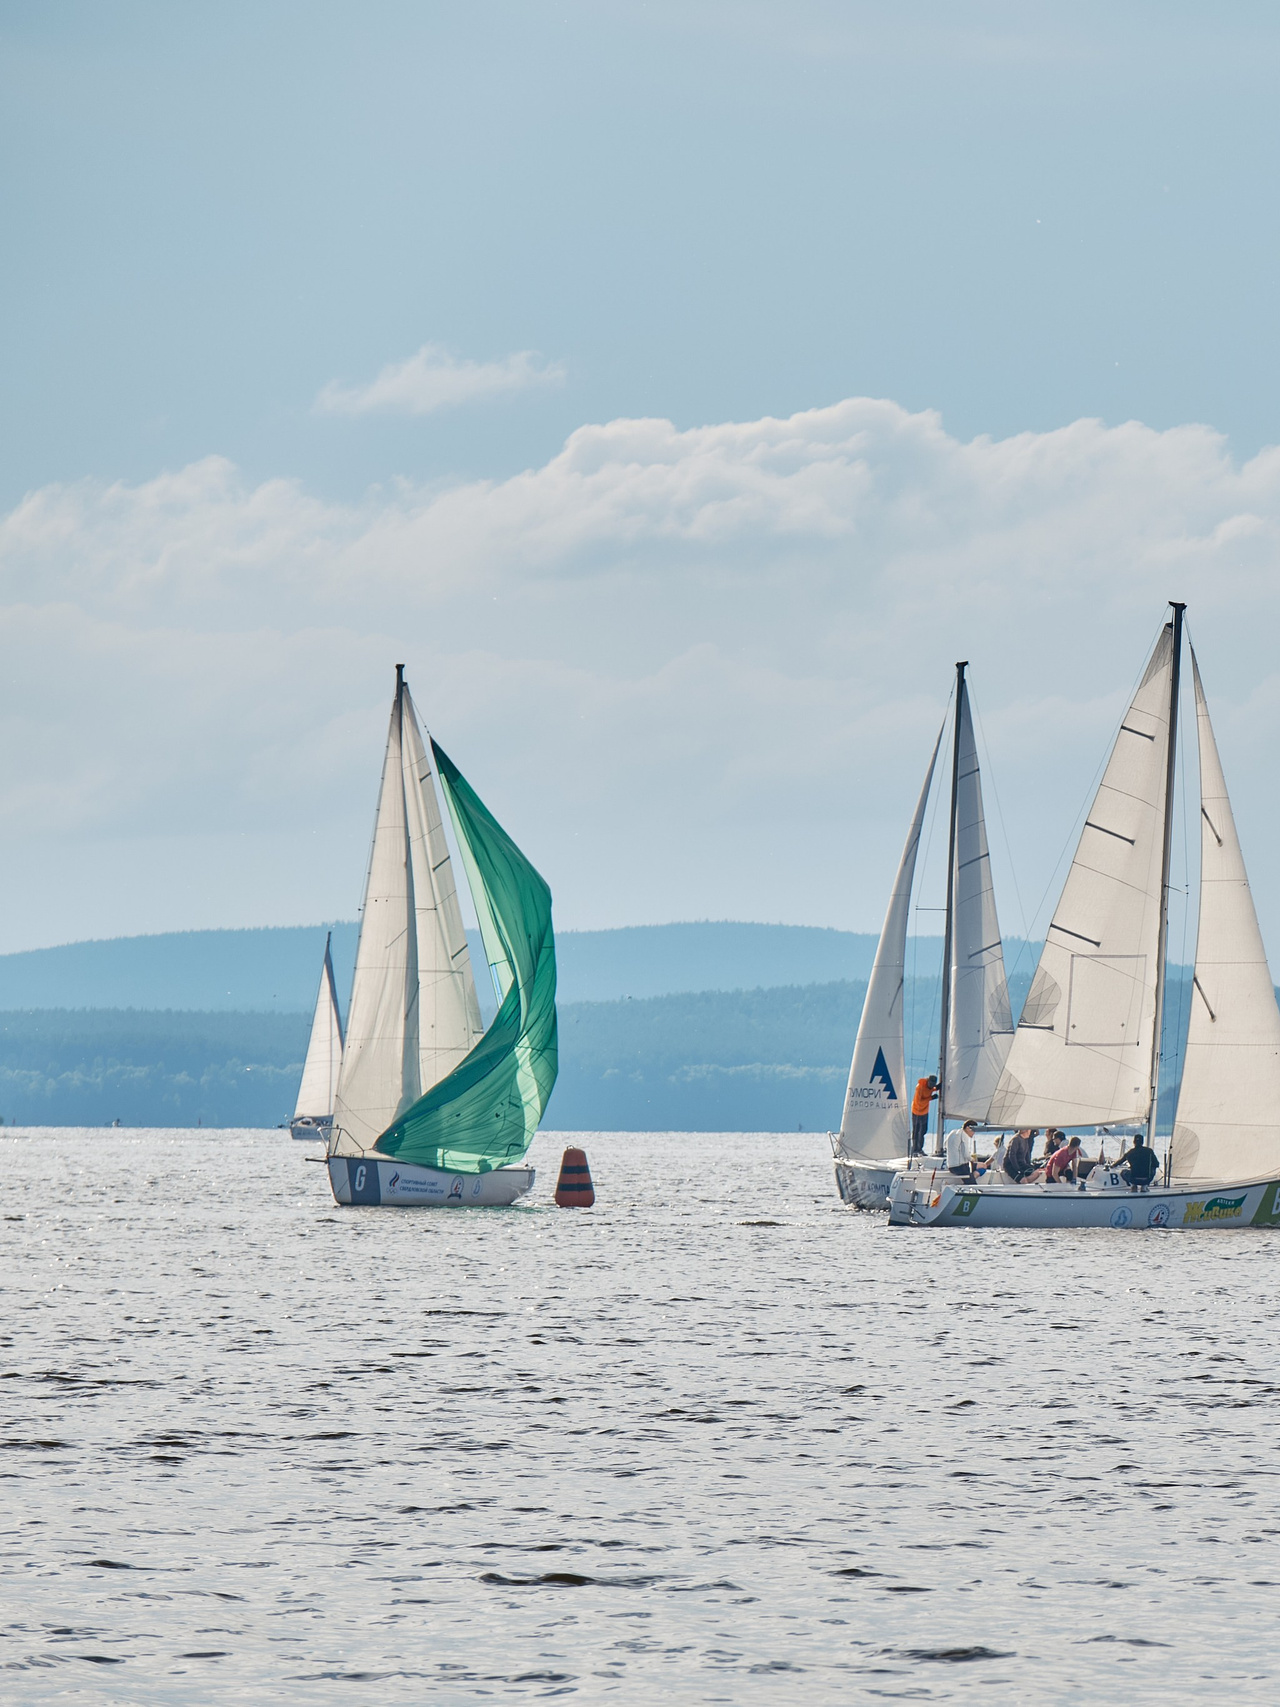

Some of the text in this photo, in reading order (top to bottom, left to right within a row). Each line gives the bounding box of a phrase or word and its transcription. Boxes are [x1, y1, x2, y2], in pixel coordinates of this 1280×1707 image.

[355, 1165, 367, 1191] G
[1109, 1173, 1120, 1186] B
[962, 1201, 971, 1213] B
